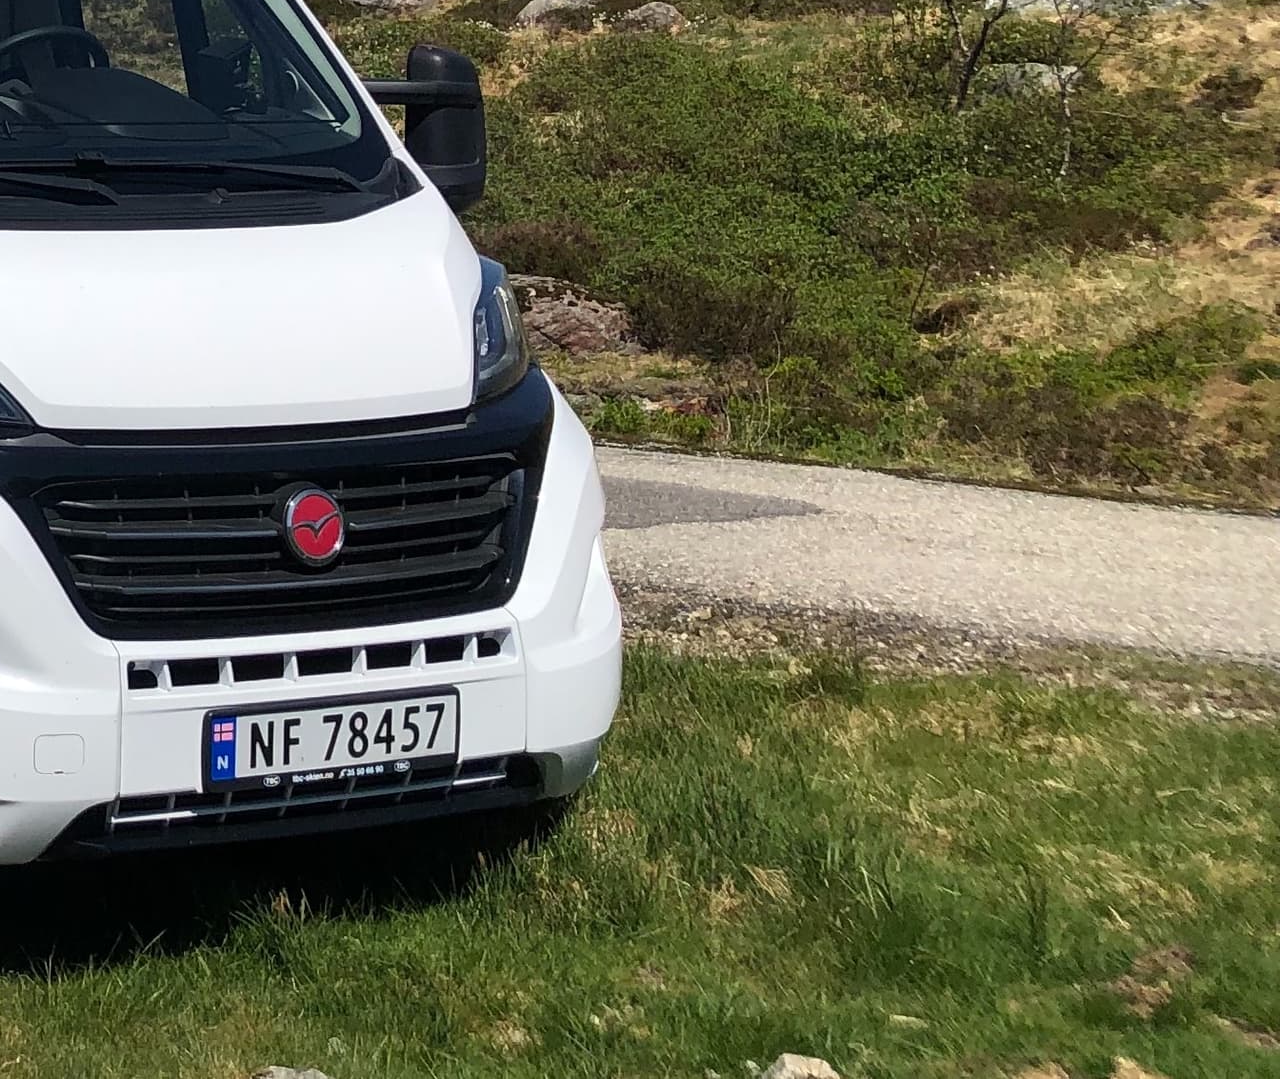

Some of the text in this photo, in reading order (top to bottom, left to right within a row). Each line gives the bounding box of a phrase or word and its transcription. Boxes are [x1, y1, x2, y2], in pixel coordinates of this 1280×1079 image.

[250, 703, 445, 769] NF 78457
[217, 755, 229, 770] N
